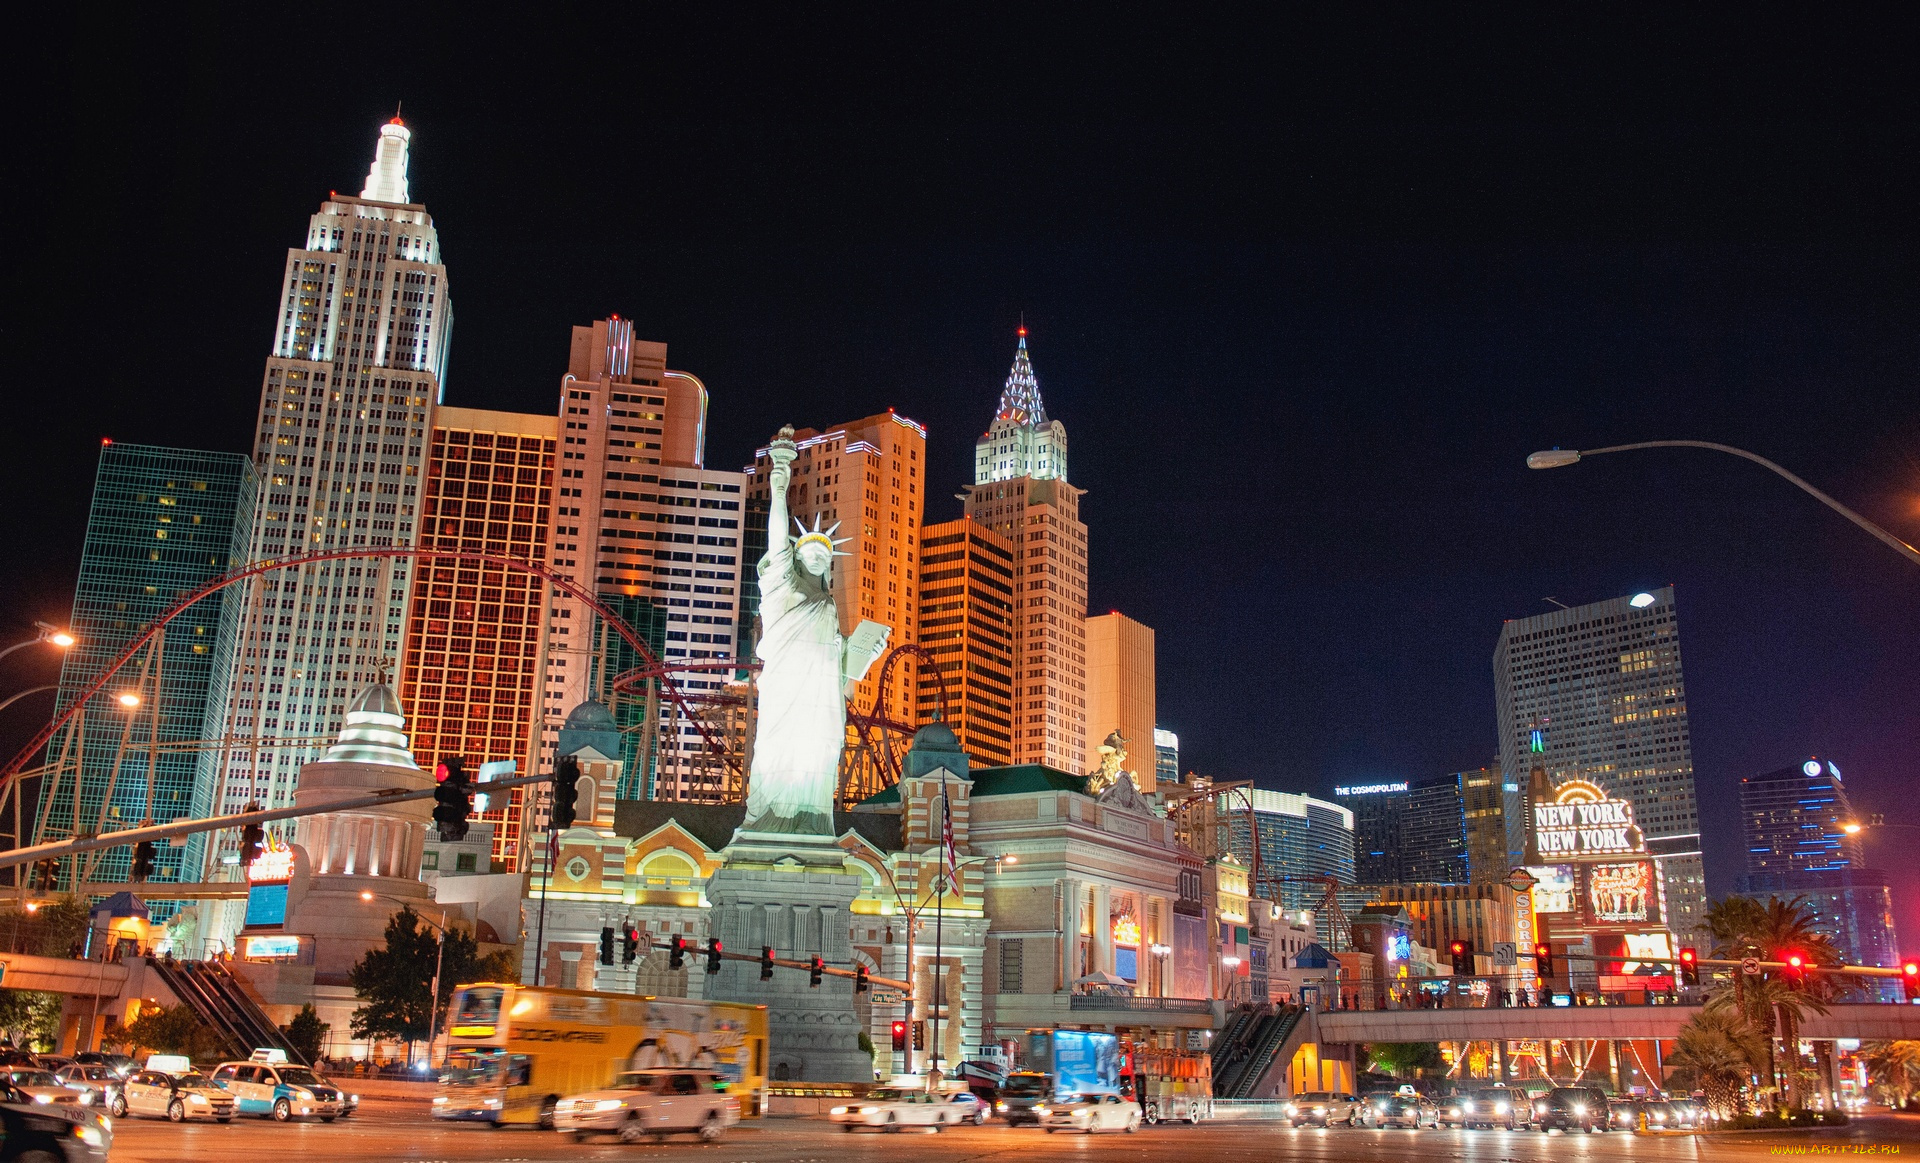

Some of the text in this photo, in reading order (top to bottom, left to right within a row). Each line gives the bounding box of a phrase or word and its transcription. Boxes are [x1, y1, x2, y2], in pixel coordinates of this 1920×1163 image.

[1335, 783, 1407, 796] THE COSMOPOLITAN
[1534, 802, 1628, 828] NEW YORK
[1536, 828, 1630, 852] NEW YORK
[1515, 894, 1533, 962] SPORTS
[62, 1109, 85, 1121] 7109
